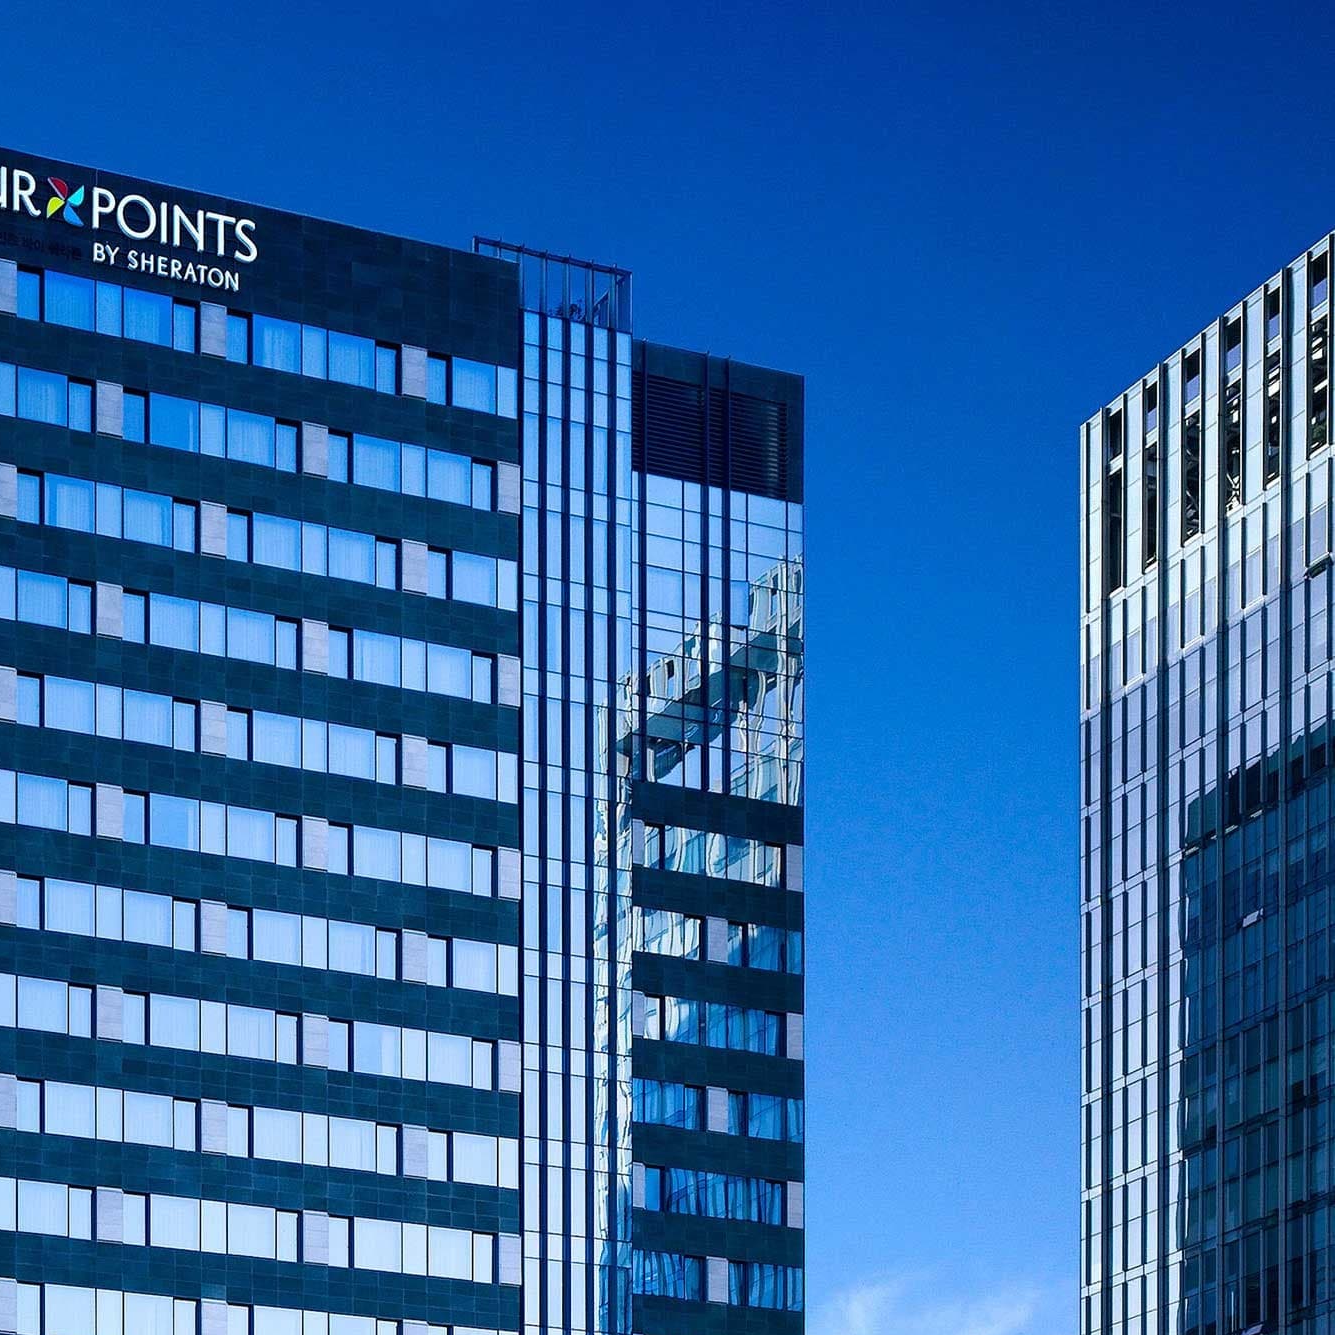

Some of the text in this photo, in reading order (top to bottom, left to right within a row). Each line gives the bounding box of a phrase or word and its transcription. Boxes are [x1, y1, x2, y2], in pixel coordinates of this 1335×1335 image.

[92, 186, 258, 263] POINTS
[92, 242, 239, 292] BY SHERATON
